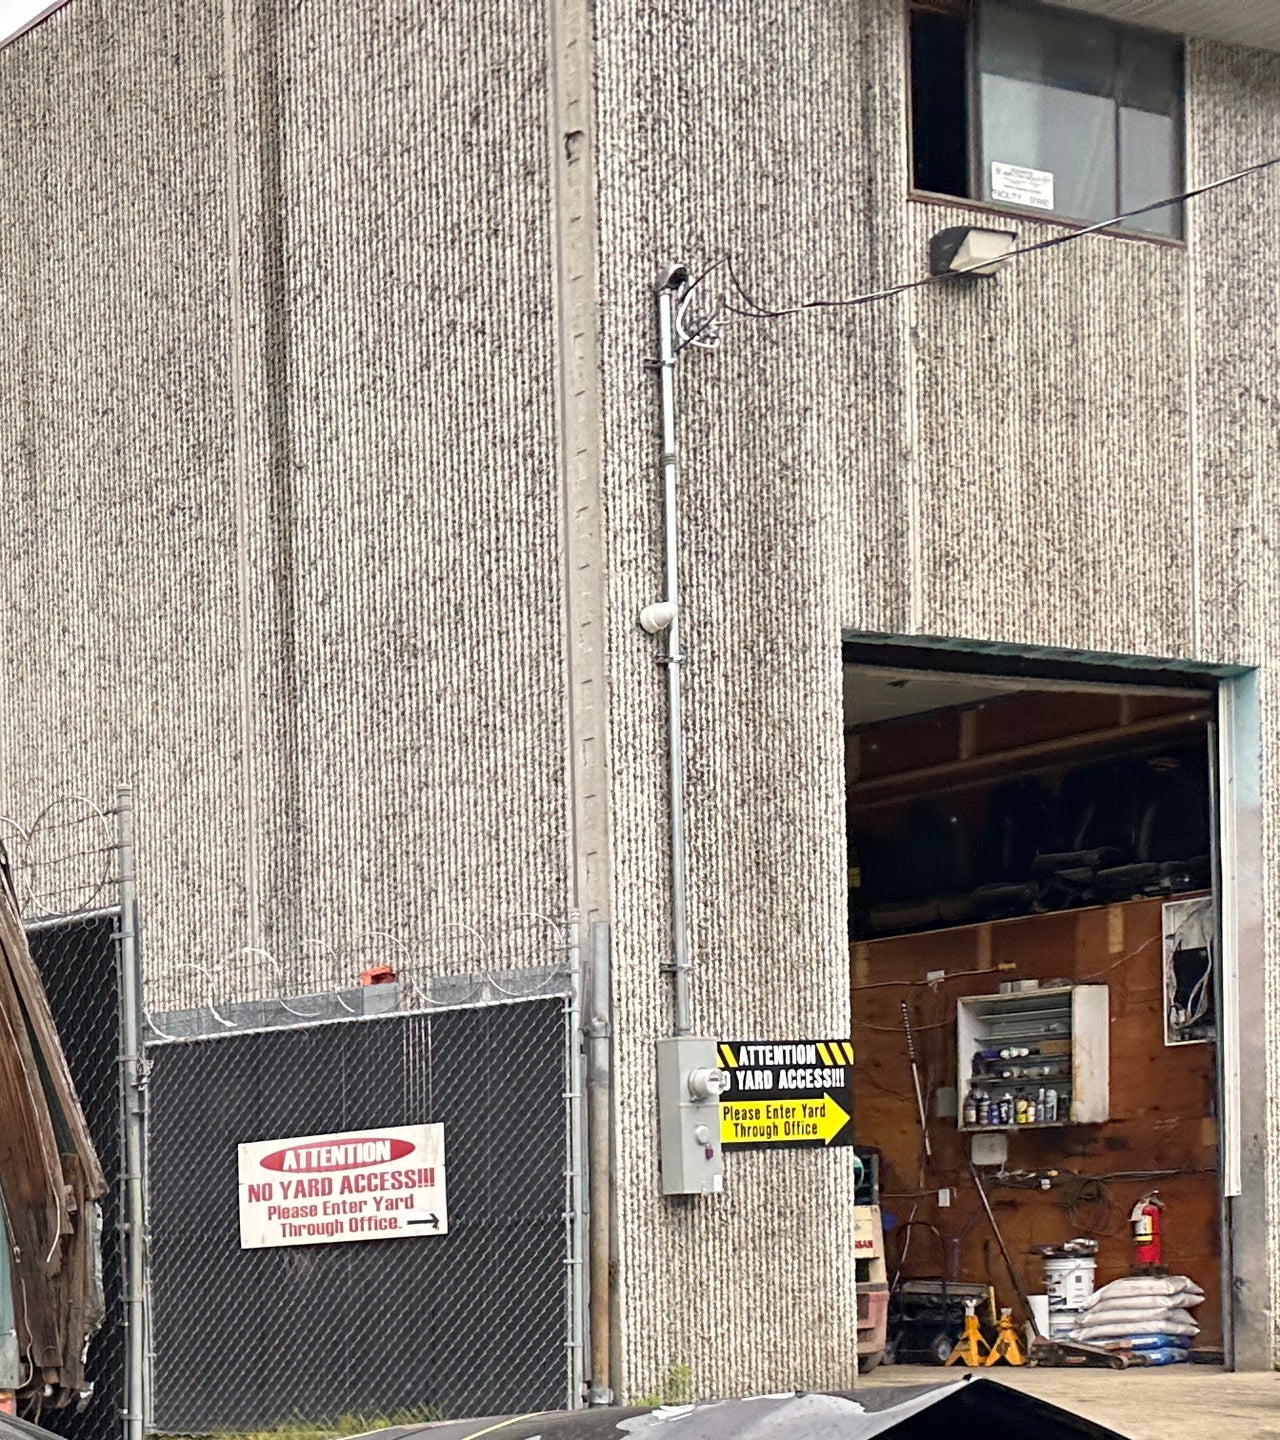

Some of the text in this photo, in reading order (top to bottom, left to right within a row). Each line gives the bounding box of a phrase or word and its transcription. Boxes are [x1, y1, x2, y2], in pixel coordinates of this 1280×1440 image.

[738, 1044, 817, 1067] ATTENTION
[736, 1069, 774, 1091] YARD
[778, 1067, 846, 1089] ACCESS!!!
[723, 1102, 827, 1122] Please Enter Yard
[732, 1120, 818, 1140] Through Office
[282, 1139, 390, 1171] ATTENTION
[247, 1168, 436, 1203] NO YARD ACCESS!!!
[267, 1194, 415, 1221] Please Enter Yard
[280, 1220, 344, 1238] Through
